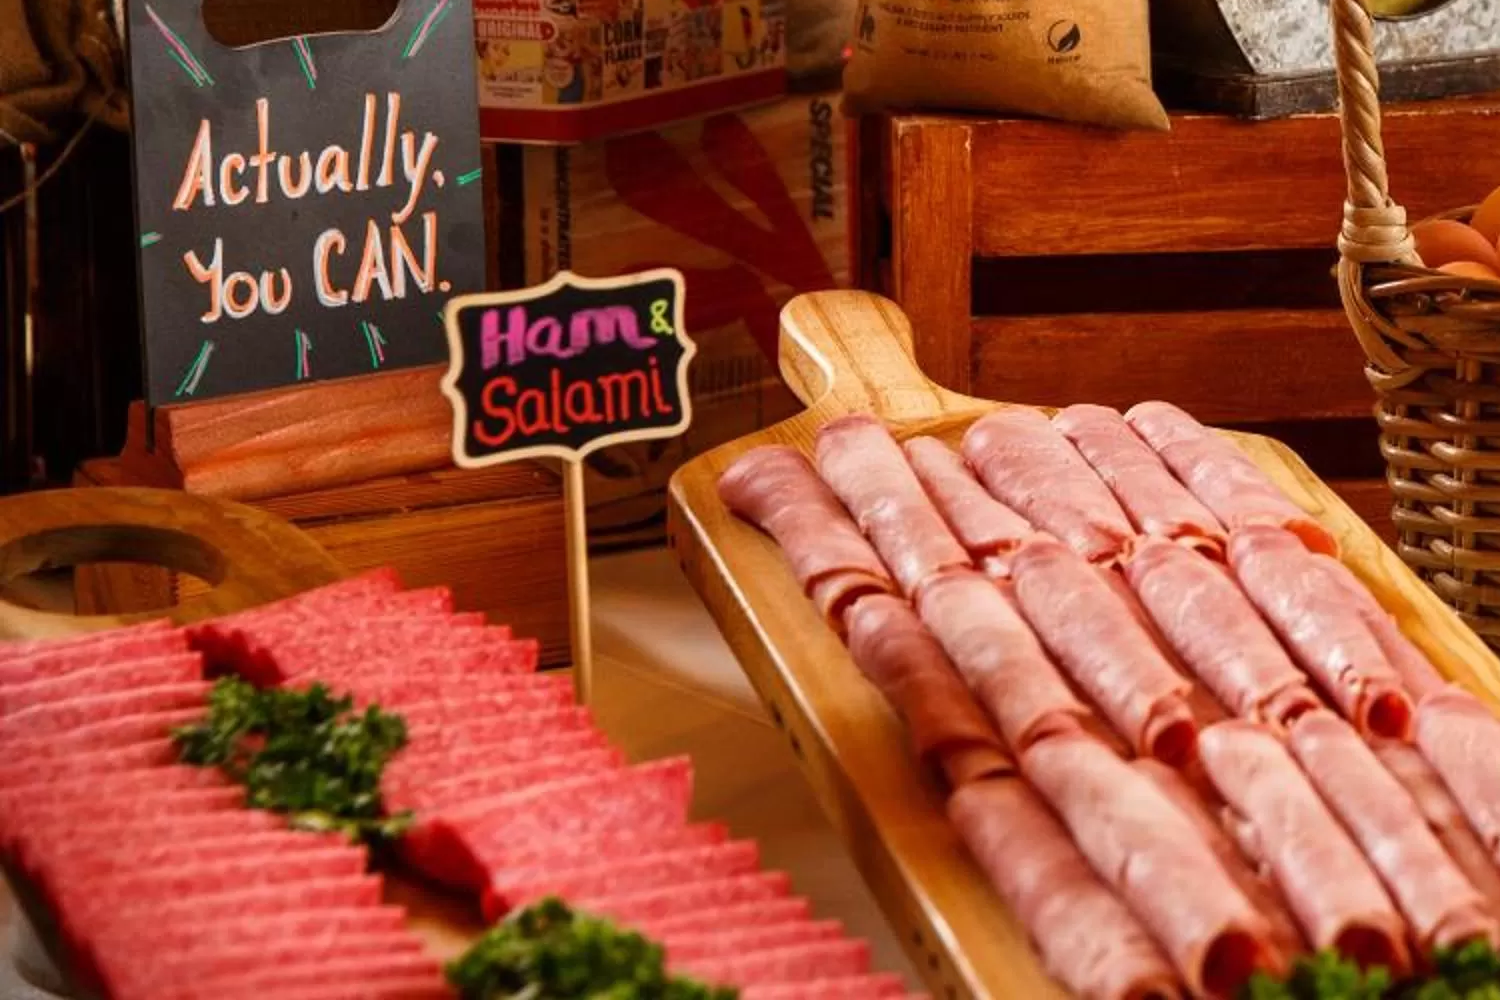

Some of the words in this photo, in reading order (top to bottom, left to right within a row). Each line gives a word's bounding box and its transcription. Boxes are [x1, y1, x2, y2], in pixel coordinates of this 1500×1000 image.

[184, 237, 292, 323] You
[313, 211, 451, 307] CAN.
[481, 305, 659, 370] Ham
[649, 299, 674, 335] &
[473, 356, 673, 446] Salami
